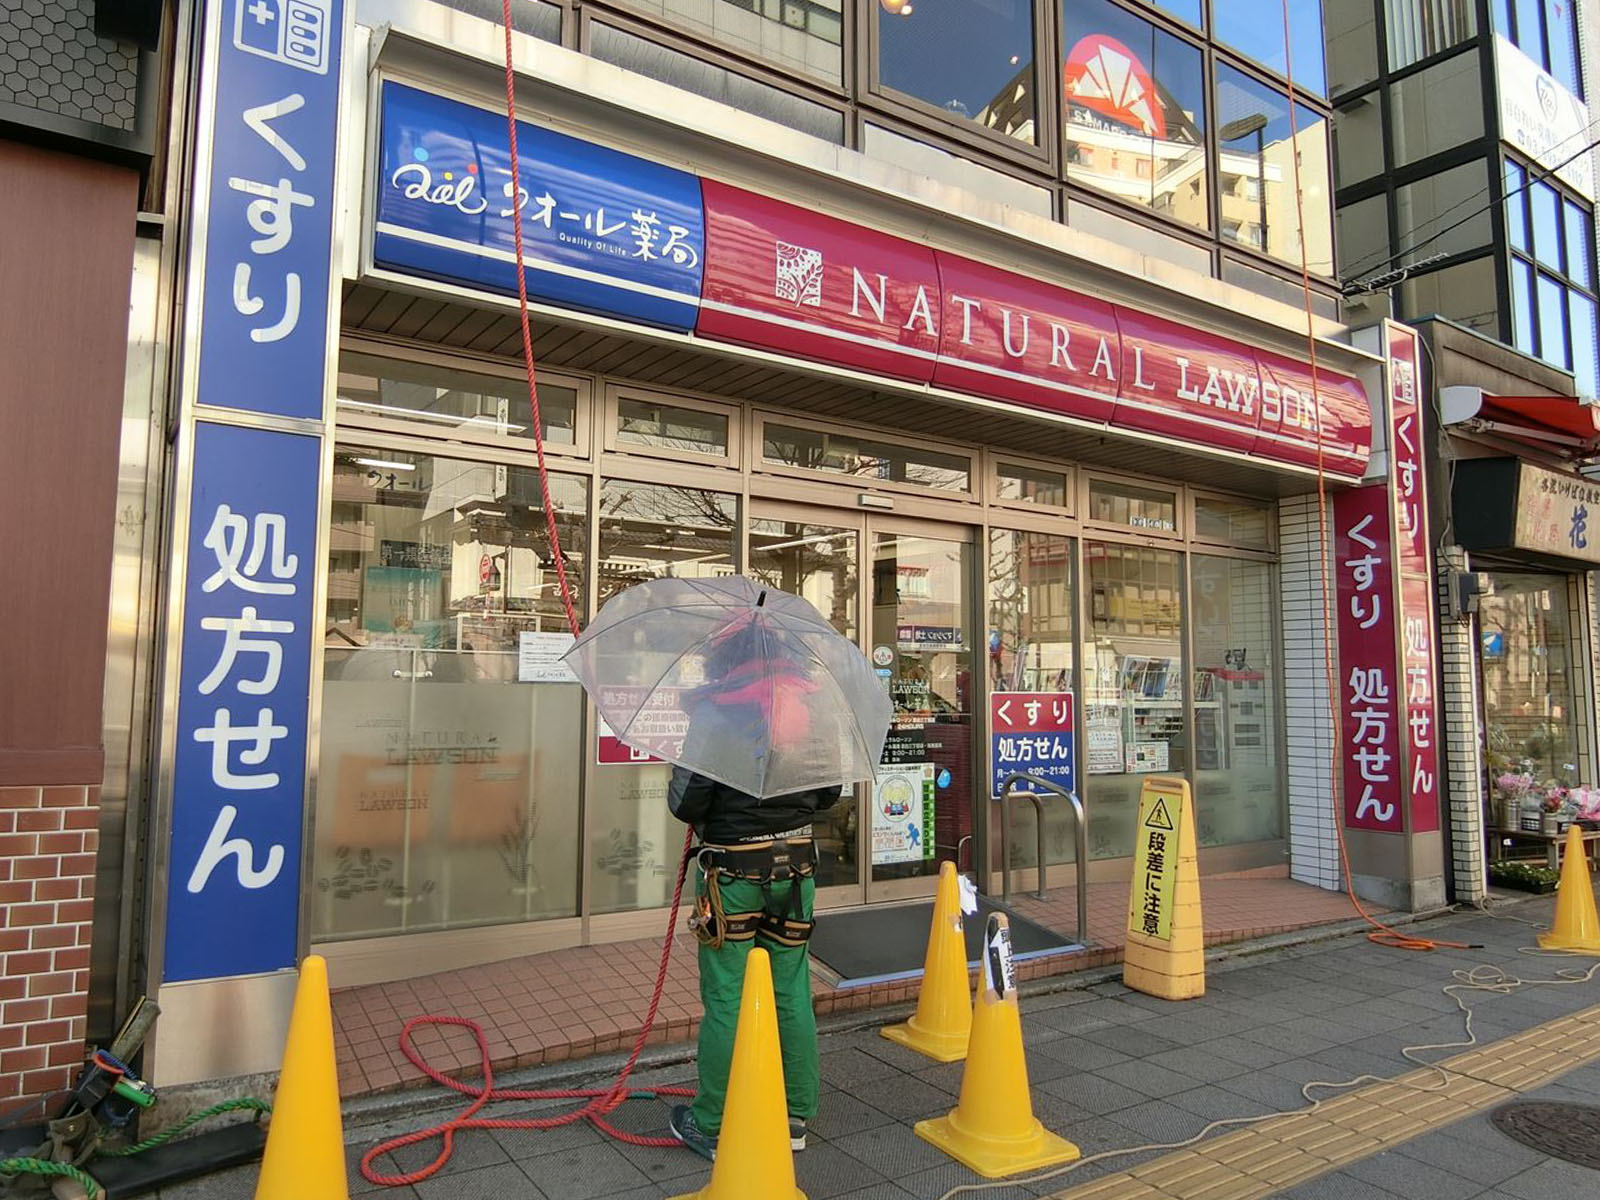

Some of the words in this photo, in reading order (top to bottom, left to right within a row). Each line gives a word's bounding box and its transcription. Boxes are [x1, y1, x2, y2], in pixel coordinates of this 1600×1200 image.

[208, 93, 315, 343] くすり
[559, 232, 592, 249] Quality
[609, 245, 626, 256] Life
[848, 266, 1156, 391] NATURAL
[1176, 356, 1325, 432] LAWSON
[1397, 415, 1420, 539] くすり
[1345, 514, 1381, 629] くすり
[187, 504, 298, 893] 処方せん
[997, 700, 1067, 726] くすり
[998, 736, 1068, 762] 処方せん
[1349, 666, 1394, 823] 処方せん
[1405, 614, 1432, 795] 処方せん
[1142, 831, 1167, 935] 段差に注意
